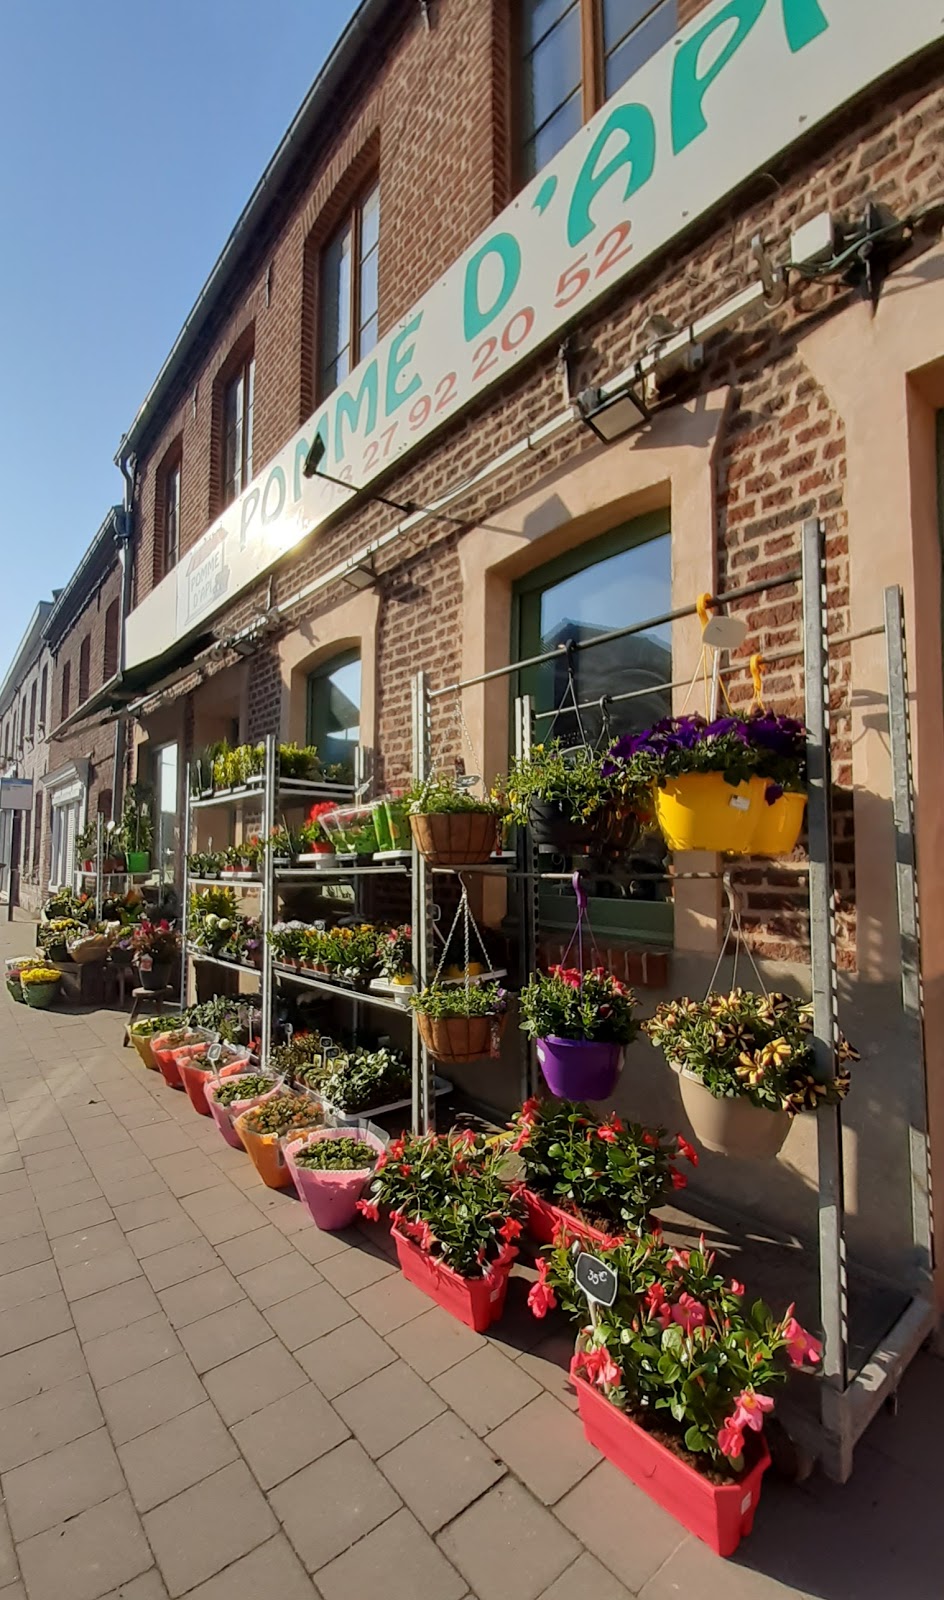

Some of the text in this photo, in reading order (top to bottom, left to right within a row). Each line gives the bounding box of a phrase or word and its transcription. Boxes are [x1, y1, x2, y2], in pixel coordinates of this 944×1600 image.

[363, 421, 399, 474] 27
[408, 371, 458, 432] 92
[471, 306, 535, 382] 20
[553, 220, 633, 309] 52
[240, 309, 424, 553] POMME
[188, 551, 220, 592] POMME
[587, 1269, 608, 1285] 35€
